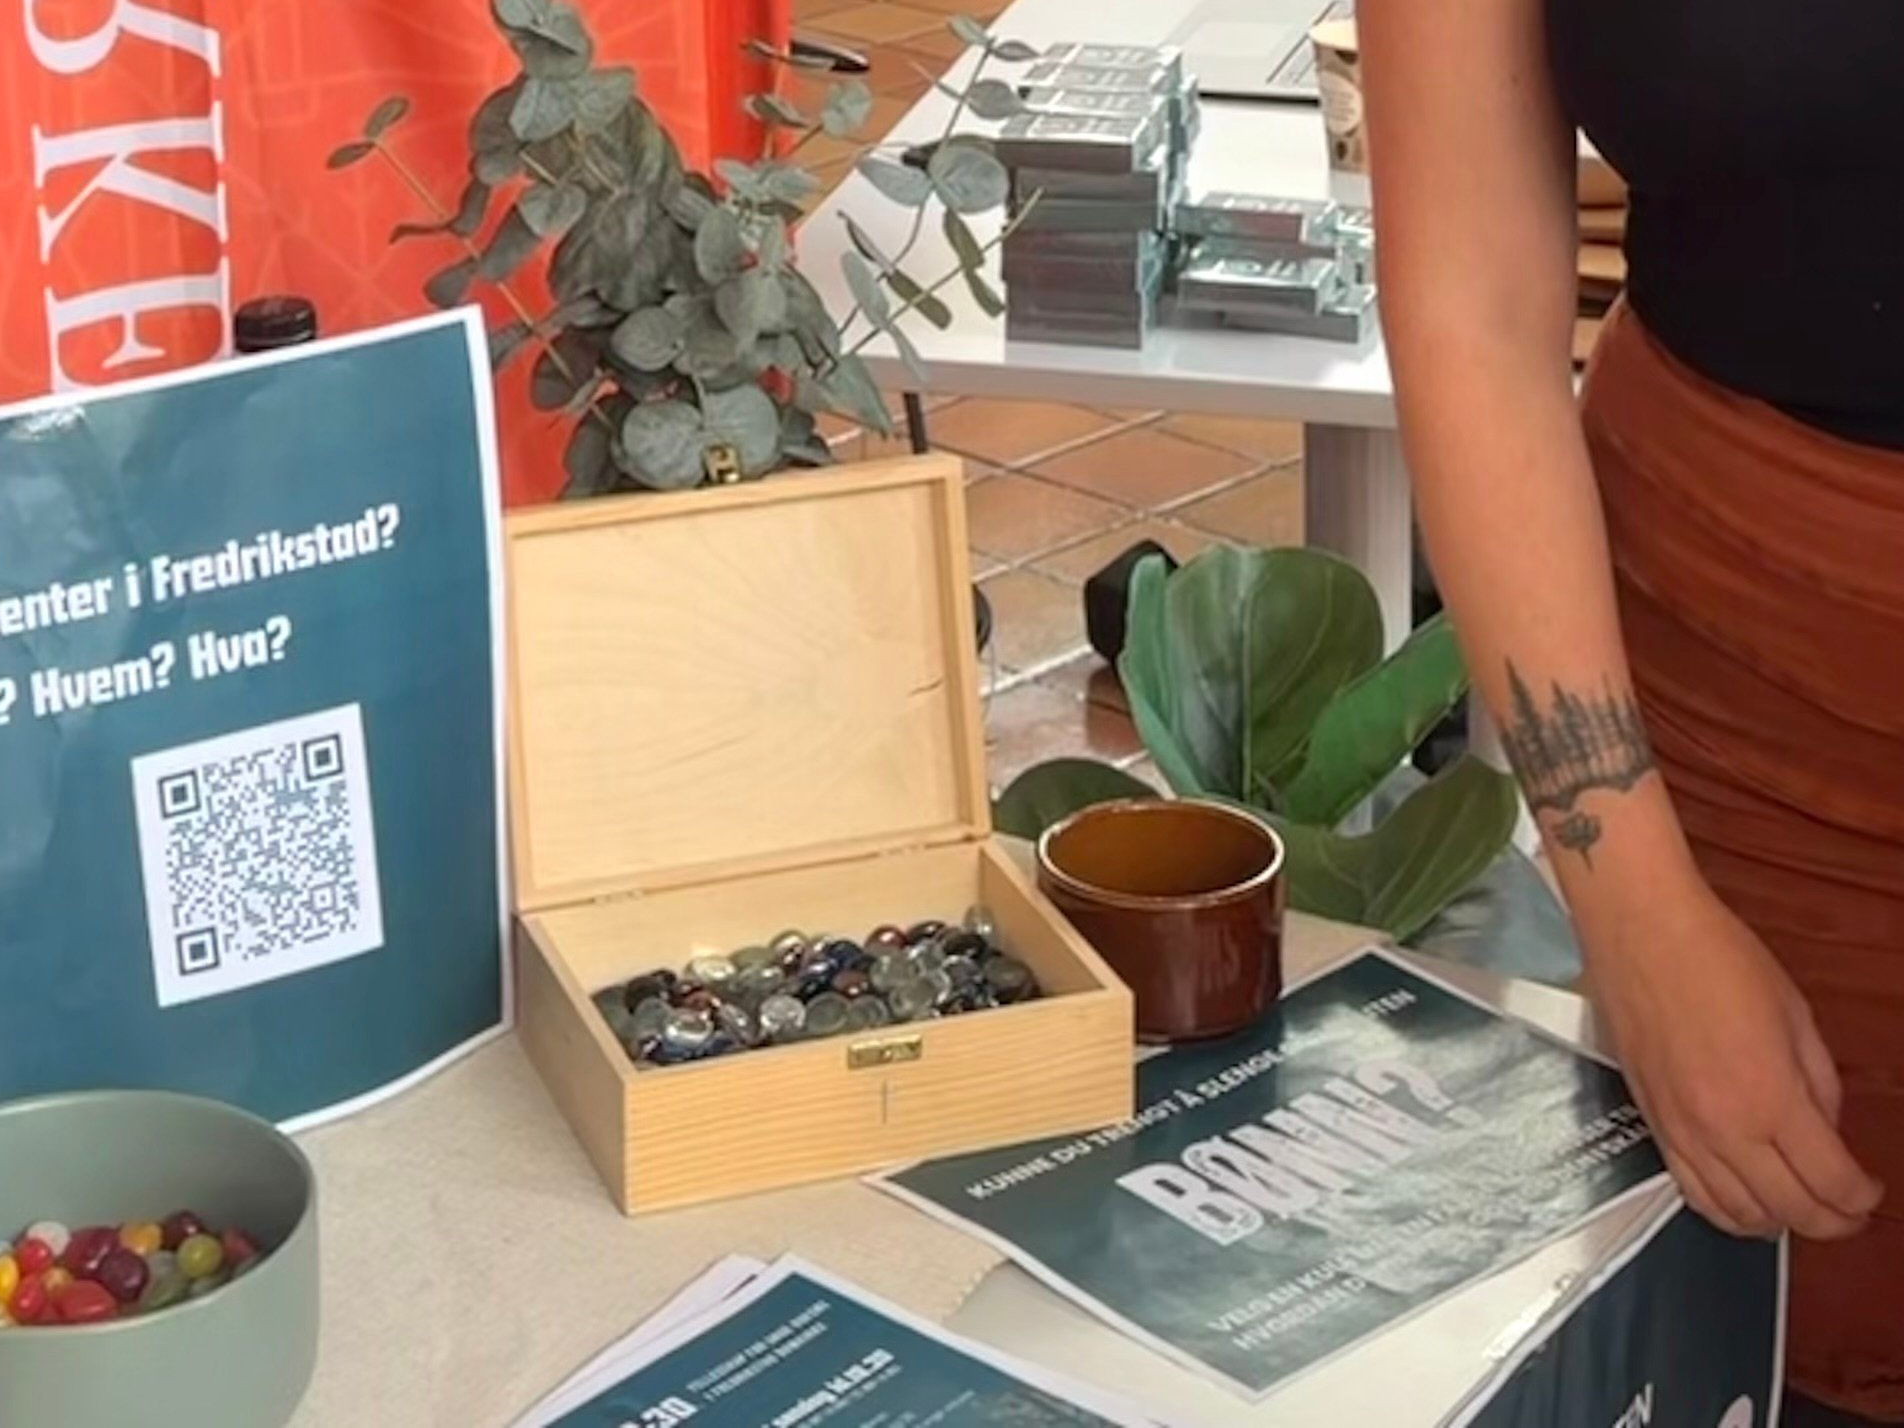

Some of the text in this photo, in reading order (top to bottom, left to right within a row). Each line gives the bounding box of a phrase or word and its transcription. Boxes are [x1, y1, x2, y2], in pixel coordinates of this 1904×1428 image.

[123, 563, 142, 608] i
[151, 503, 400, 603] Fredrikstad?
[30, 641, 176, 718] Hvem?
[187, 614, 293, 680] Hva?
[1114, 1056, 1482, 1247] BØNN?
